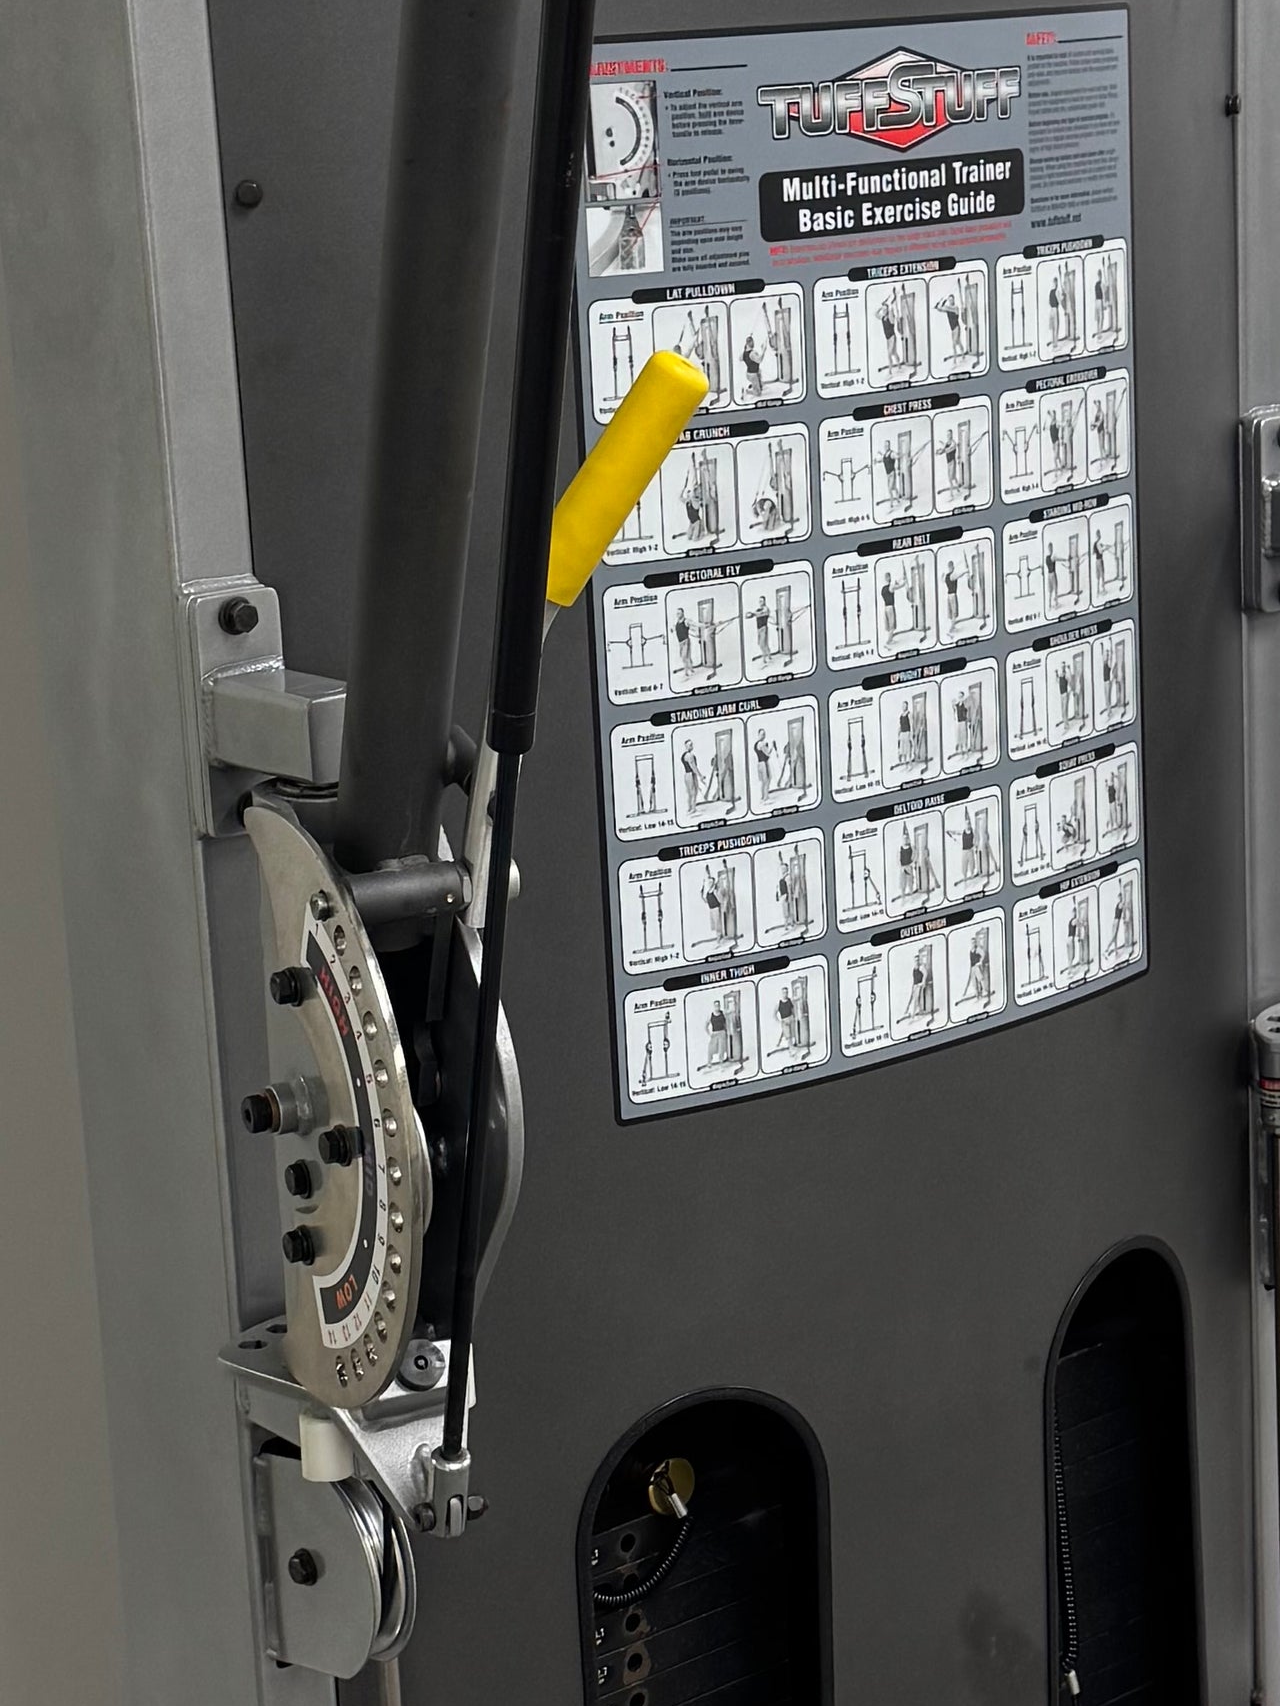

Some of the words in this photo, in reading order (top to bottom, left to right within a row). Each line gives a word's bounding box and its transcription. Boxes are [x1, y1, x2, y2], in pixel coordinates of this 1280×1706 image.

[758, 62, 1020, 141] TUFFSTUFF
[782, 163, 946, 202] Multi-Functional
[952, 159, 1012, 184] Trainer
[798, 205, 855, 232] Basic
[861, 197, 942, 227] Exercise
[947, 190, 996, 217] Guide
[666, 287, 682, 300] LAT
[685, 283, 736, 299] PULLDOWN
[883, 402, 908, 415] CHEST
[909, 398, 932, 411] PRESS
[694, 427, 730, 440] CRUNCH
[679, 568, 724, 583] PECTORAL
[726, 565, 741, 577] FLY
[670, 708, 714, 723] STANDING
[716, 704, 736, 715] ARM
[739, 700, 762, 712] CURL
[678, 841, 715, 856] TRICEPS
[717, 833, 767, 849] PUSHDOWN
[900, 923, 924, 938] OUTER
[701, 971, 727, 984] INNER
[729, 964, 755, 979] THIGH
[318, 966, 349, 1037] HIGH
[335, 1274, 358, 1310] LOW
